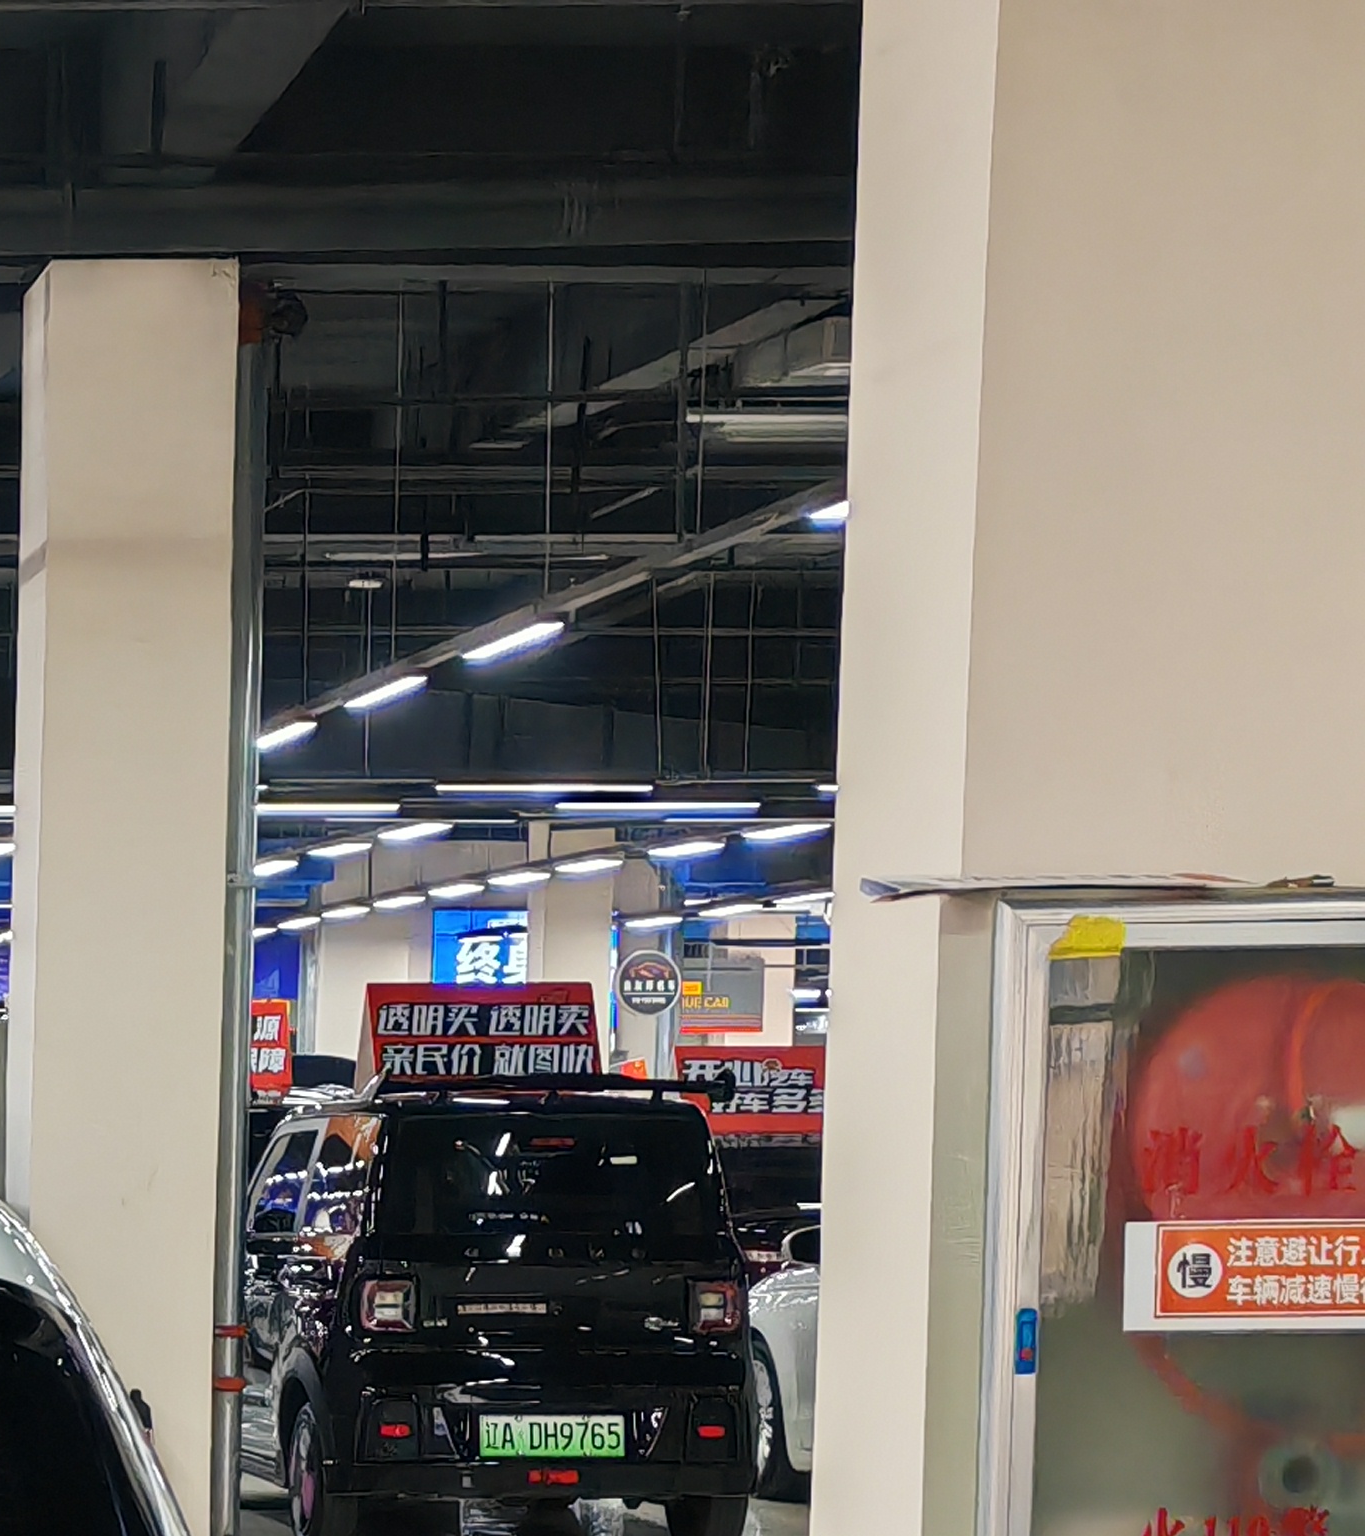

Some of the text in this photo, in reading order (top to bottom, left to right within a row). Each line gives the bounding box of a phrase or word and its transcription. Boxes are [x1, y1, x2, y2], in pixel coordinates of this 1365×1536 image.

[377, 1004, 590, 1036] 透明买 透明卖
[251, 1047, 287, 1074] 障
[382, 1044, 595, 1076] 亲民价 就图快
[1141, 1123, 1358, 1197] 消火栓
[1226, 1235, 1365, 1267] 注意避让行
[1176, 1252, 1213, 1289] 慢
[1226, 1274, 1365, 1306] 车辆减速慢
[485, 1422, 621, 1450] 辽A DH9765
